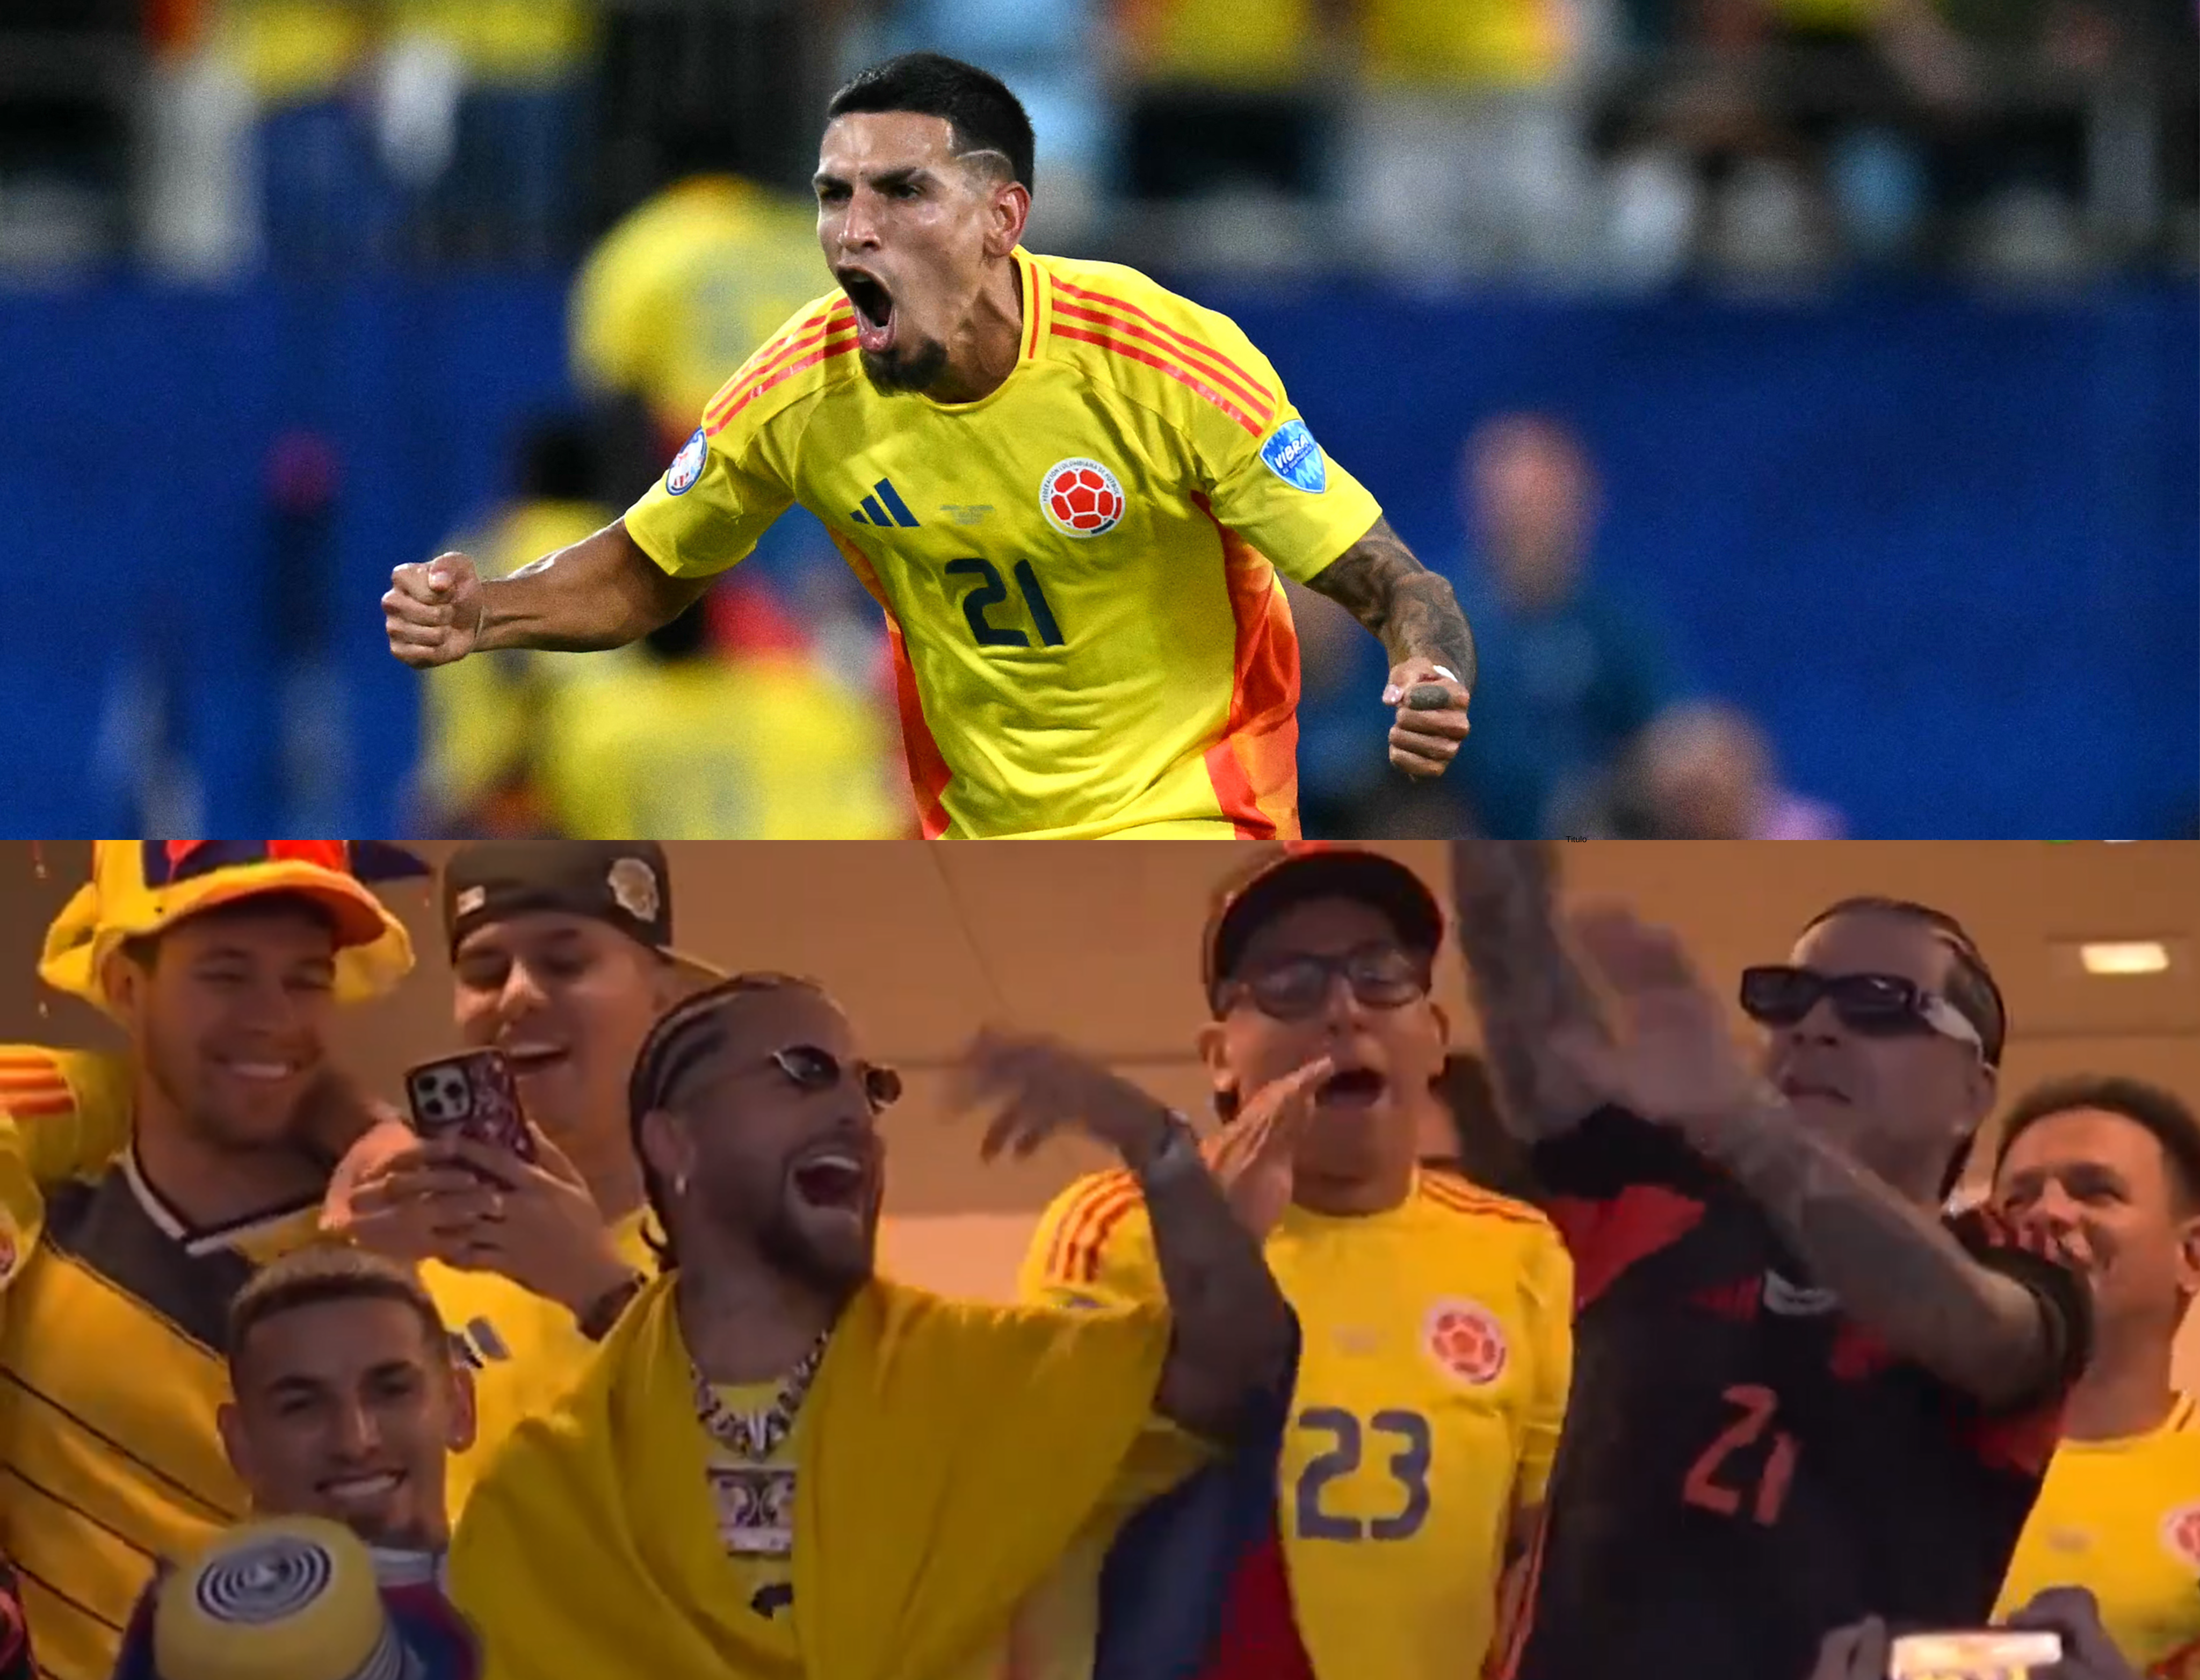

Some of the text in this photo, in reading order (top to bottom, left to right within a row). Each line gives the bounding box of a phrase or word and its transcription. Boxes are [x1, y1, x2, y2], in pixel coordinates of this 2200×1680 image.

[1274, 434, 1309, 469] VIBRA
[944, 558, 1065, 647] 21
[1296, 1407, 1431, 1543] 23
[1684, 1384, 1796, 1527] 21
